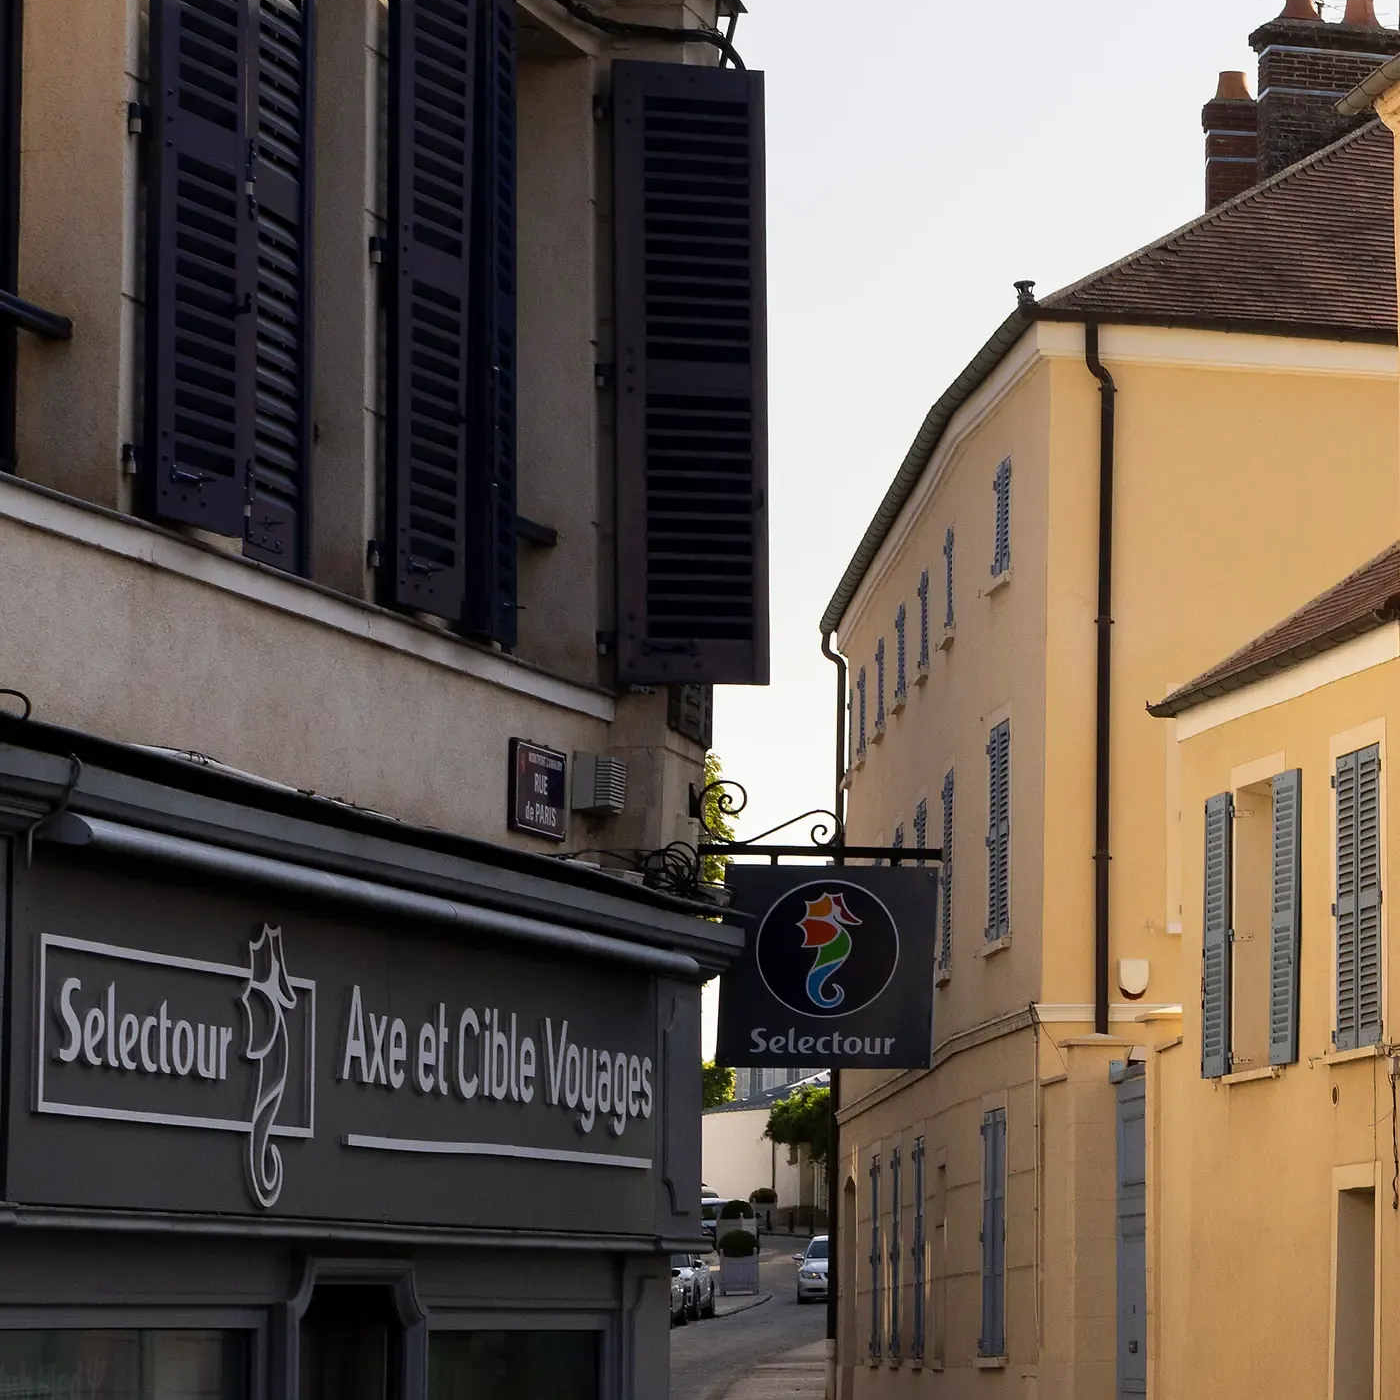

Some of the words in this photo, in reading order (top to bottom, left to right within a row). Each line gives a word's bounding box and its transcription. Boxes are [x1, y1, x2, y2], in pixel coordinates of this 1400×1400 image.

[534, 772, 548, 796] RUE
[525, 801, 534, 821] de
[535, 803, 557, 828] PARIS
[59, 977, 233, 1080] Selectour
[749, 1027, 896, 1056] Selectour
[342, 985, 407, 1089] Axe
[417, 1002, 449, 1096] et
[458, 1006, 536, 1103] Cible
[545, 1017, 653, 1136] Voyages
